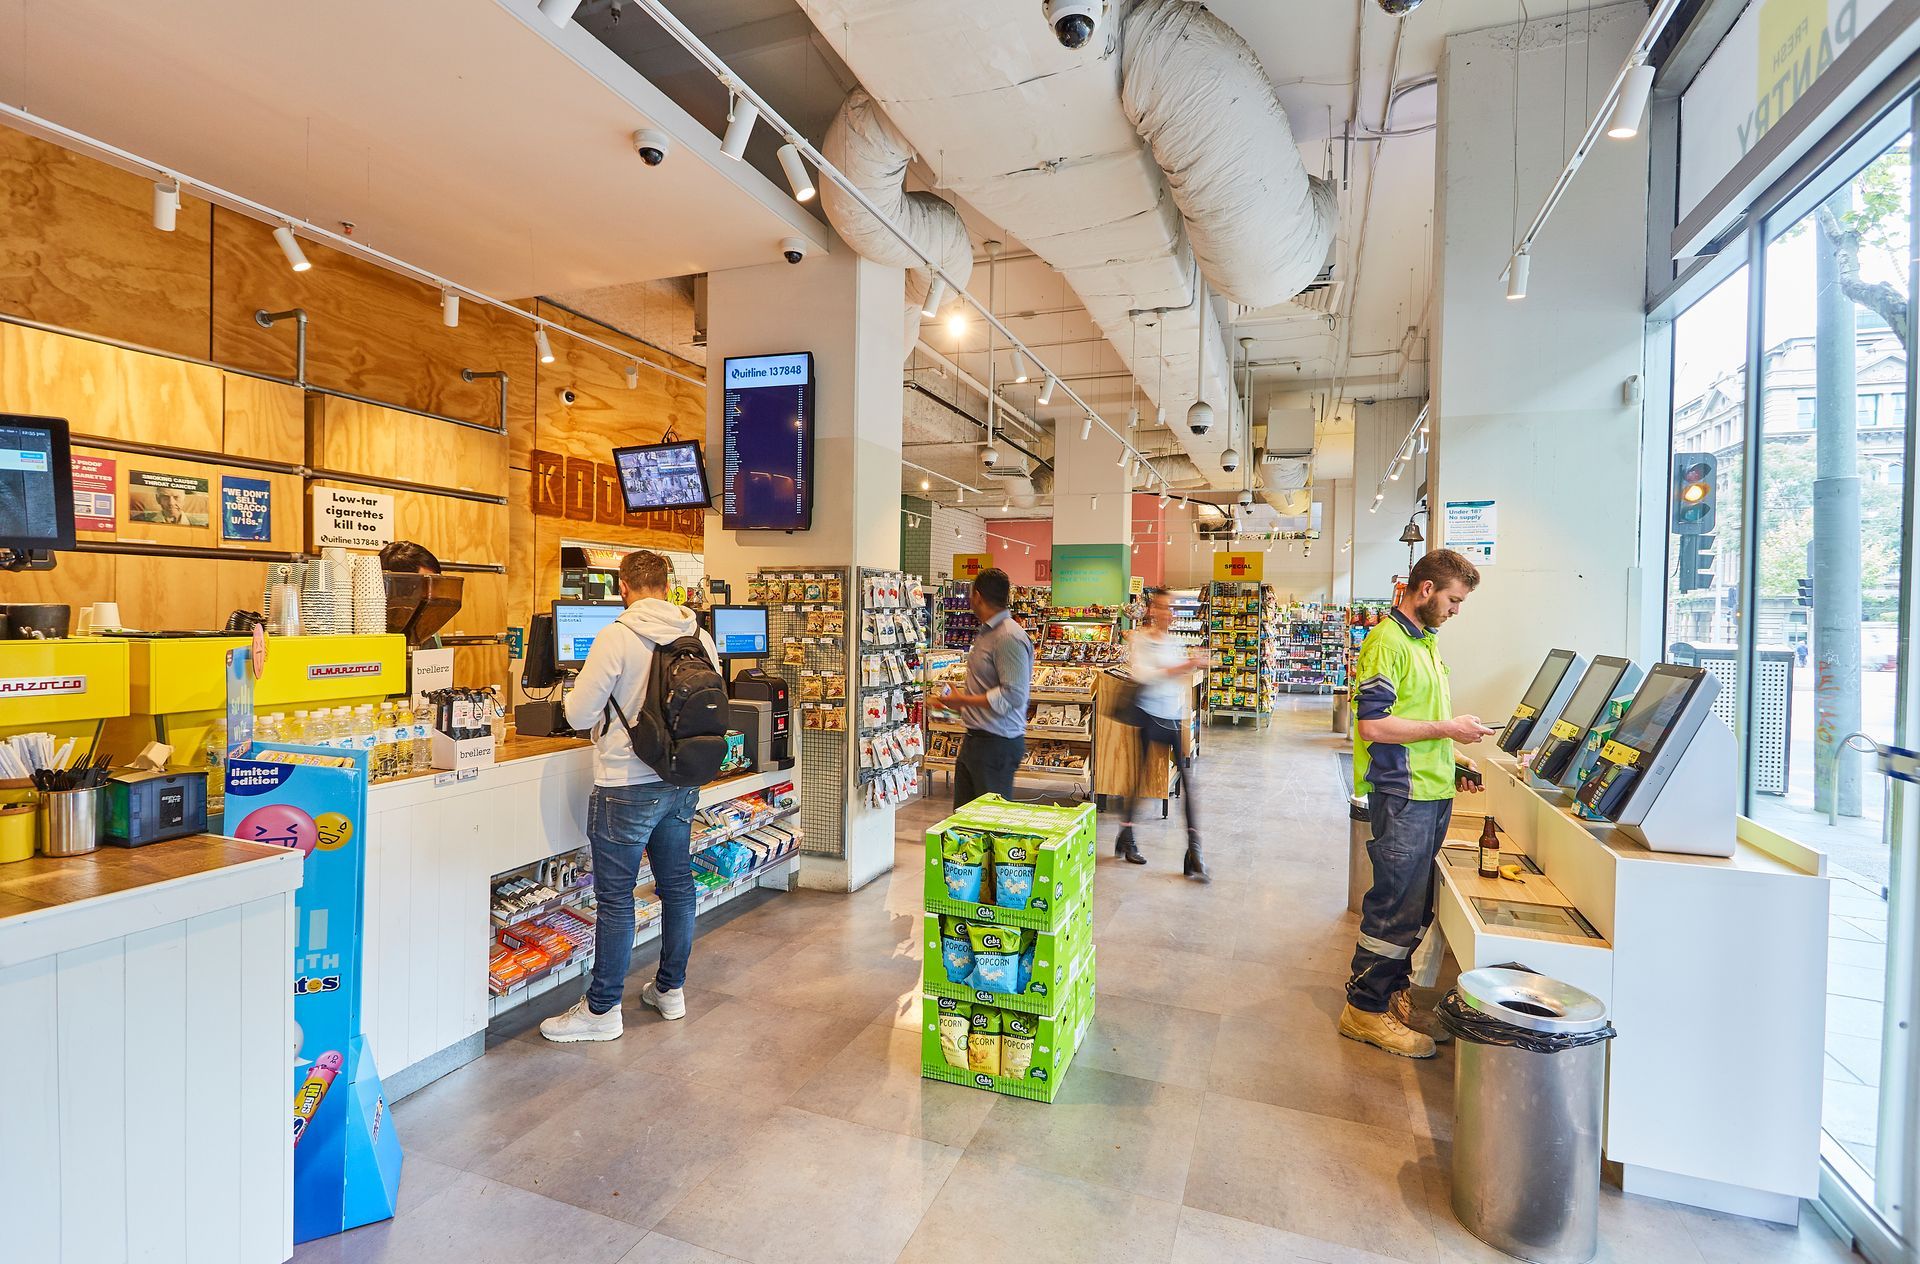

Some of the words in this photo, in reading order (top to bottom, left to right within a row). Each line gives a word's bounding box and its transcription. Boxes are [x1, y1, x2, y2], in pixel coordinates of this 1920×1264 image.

[732, 368, 767, 380] Quitline
[72, 472, 113, 481] IGARETTES
[142, 474, 172, 482] SMOKING
[173, 476, 198, 485] CAUSES
[243, 490, 270, 499] DON'T
[332, 492, 378, 506] Low-tar
[236, 496, 257, 505] SELL
[226, 502, 267, 512] TOBACCO
[326, 506, 384, 520] cigarettes
[334, 519, 353, 530] kill
[358, 522, 376, 532] too
[321, 535, 352, 544] Quitline
[416, 665, 450, 675] brellerz
[0, 680, 81, 692] ARZOCCO
[460, 748, 491, 759] brellerz
[231, 766, 279, 777] limited
[231, 776, 279, 786] edition
[1009, 848, 1026, 860] Cobs
[945, 865, 973, 876] OPCORN
[1000, 868, 1033, 877] POPCORN
[978, 907, 994, 919] Cobs
[984, 935, 1001, 948] Cobs
[946, 942, 972, 953] POPCO
[296, 953, 339, 973] ITH
[294, 976, 340, 994] tos
[977, 991, 993, 1003] Cobs
[939, 999, 956, 1010] Cobs
[940, 1018, 962, 1027] PCORN
[973, 1015, 987, 1028] Cobs
[976, 1074, 993, 1087] Cobs
